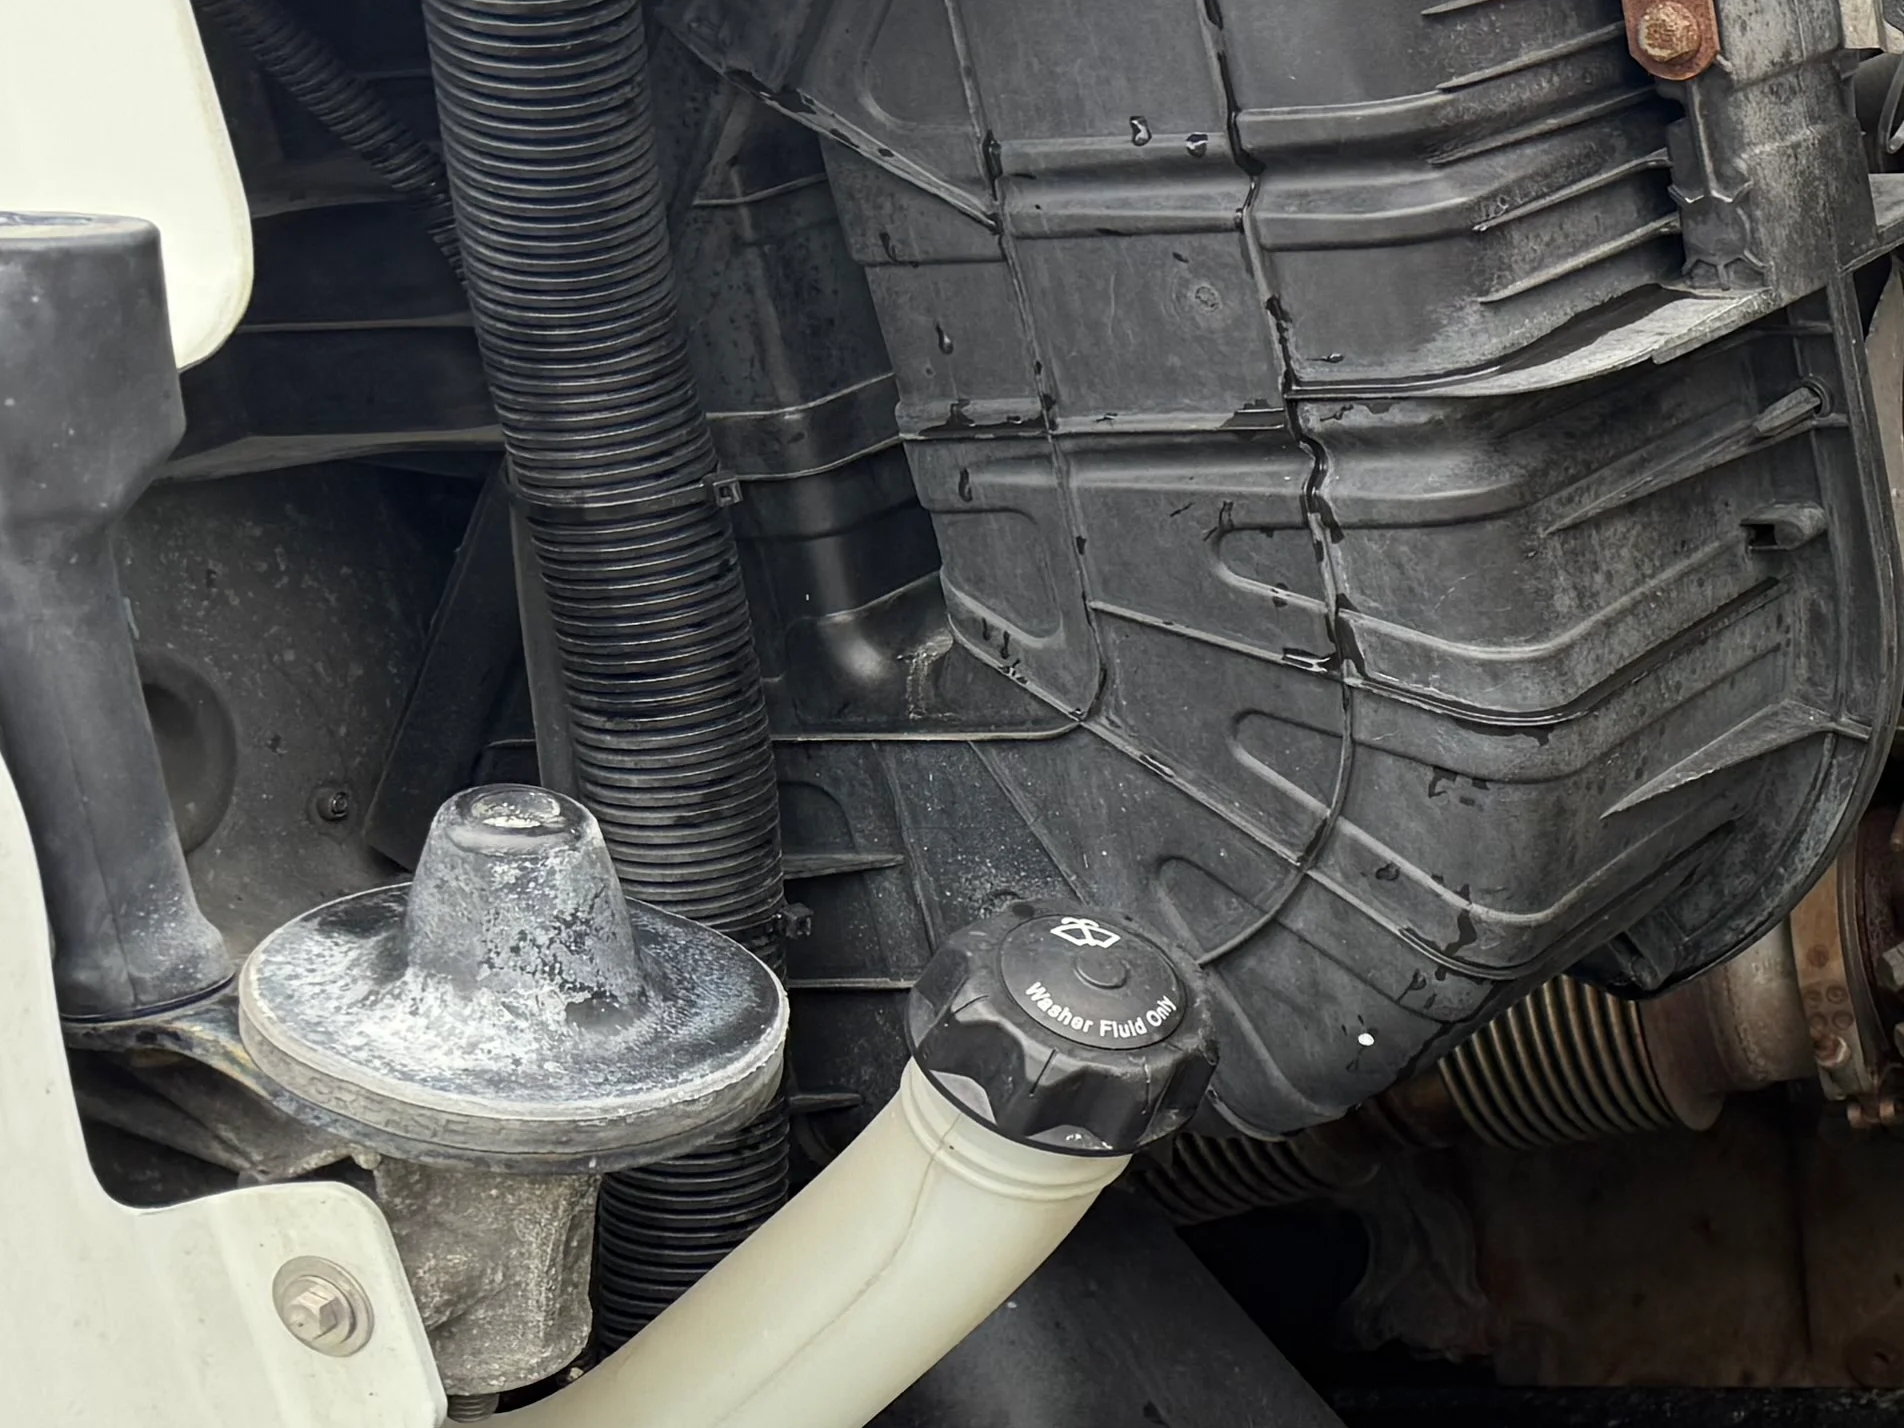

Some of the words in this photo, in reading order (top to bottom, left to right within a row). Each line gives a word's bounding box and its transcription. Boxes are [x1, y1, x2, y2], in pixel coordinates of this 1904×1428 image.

[1025, 981, 1094, 1033] Washer
[1100, 1017, 1147, 1038] Fluid
[1146, 995, 1177, 1027] Only
